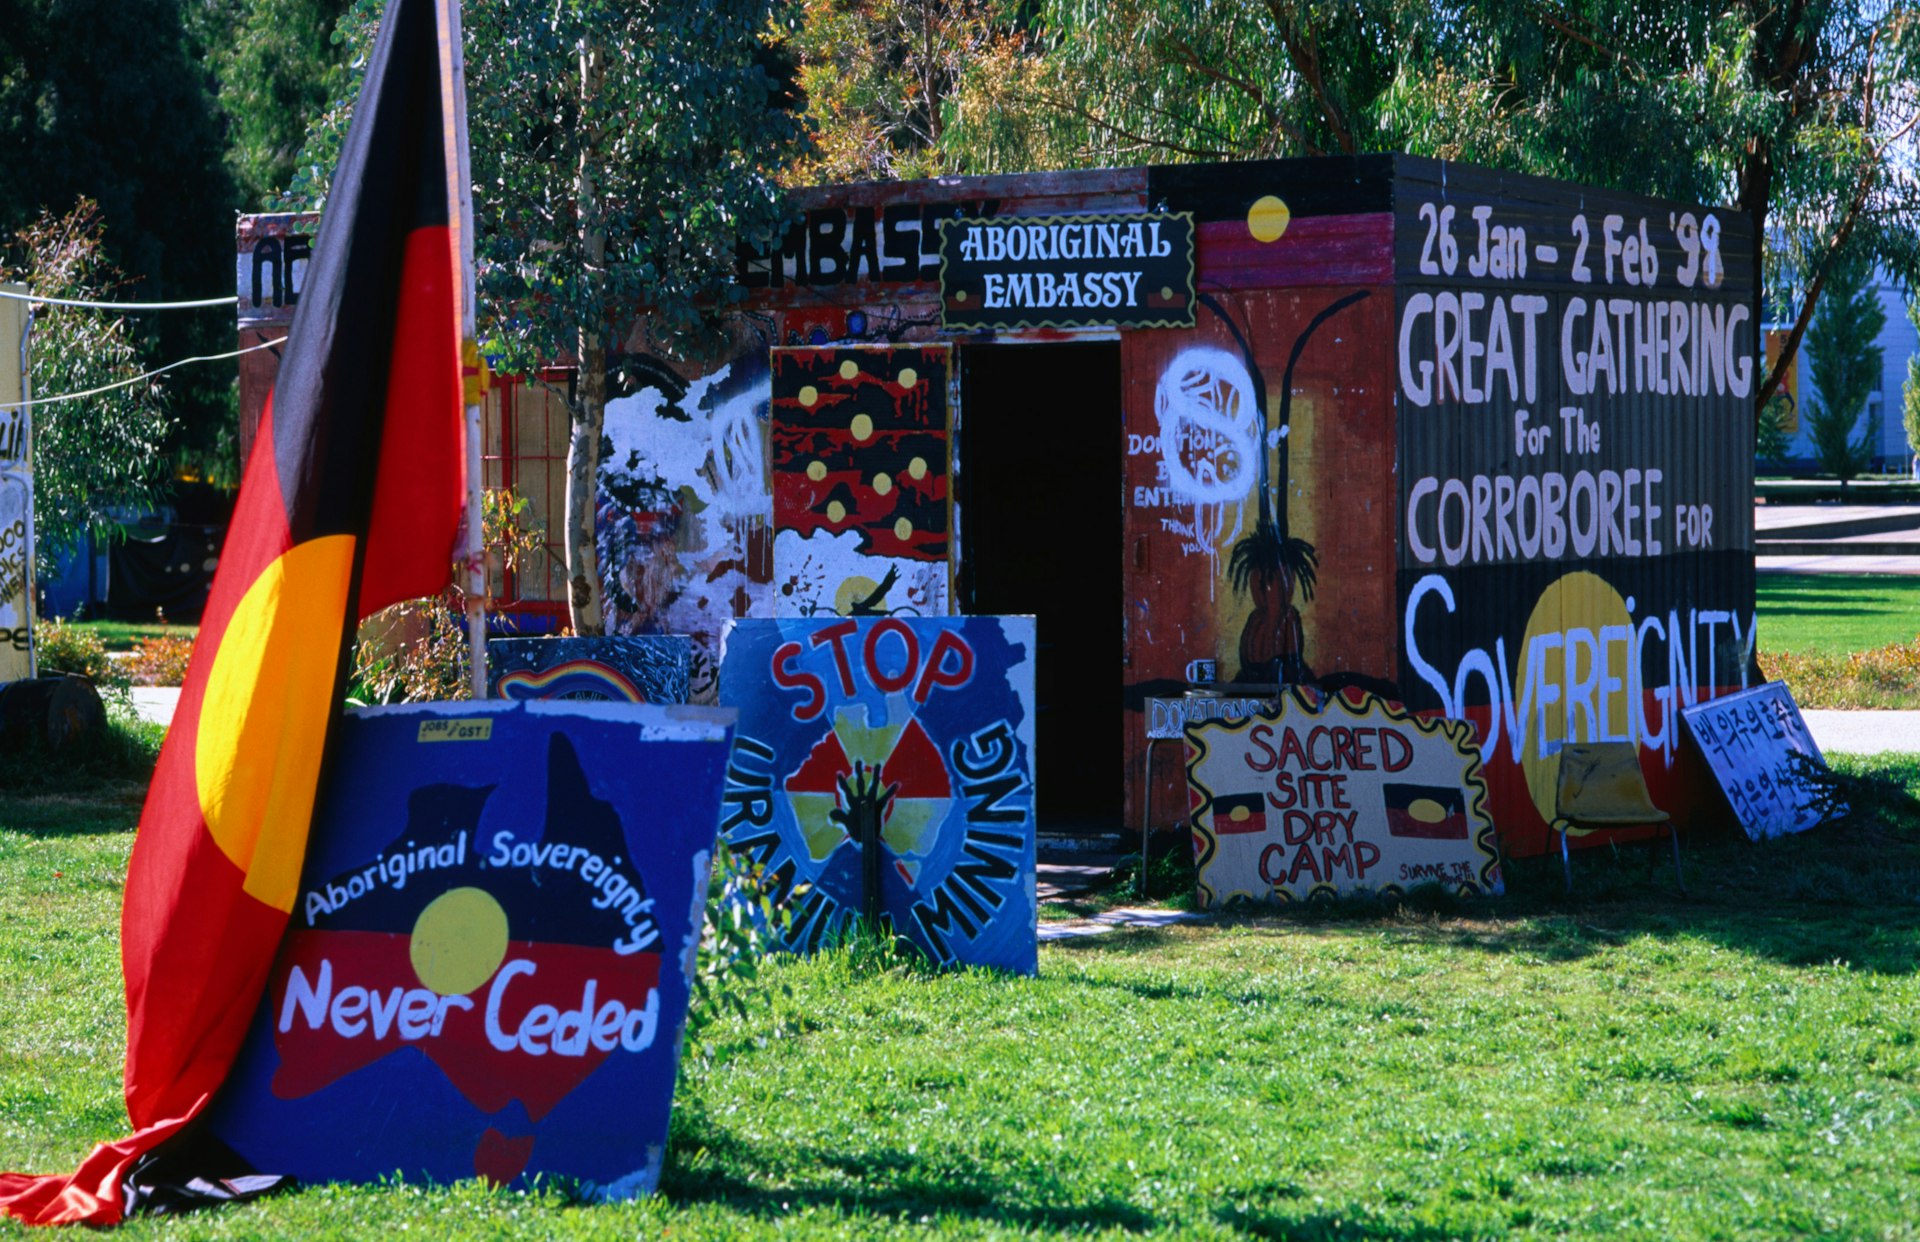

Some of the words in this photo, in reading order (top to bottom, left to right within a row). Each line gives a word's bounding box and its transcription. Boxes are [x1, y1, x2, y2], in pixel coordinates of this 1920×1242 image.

[735, 199, 1000, 288] EMBASS
[959, 221, 1172, 262] ABORIGINAL
[1419, 202, 1458, 277] 26
[1468, 206, 1527, 279] Jan
[1571, 214, 1592, 283] 2
[1603, 214, 1659, 287] Feb
[983, 272, 1143, 309] EMBASSY
[1399, 292, 1549, 407] GREAT
[1561, 297, 1754, 399] GATHERING
[1559, 406, 1601, 455] The
[1408, 468, 1664, 567] CORROBOREE
[1676, 503, 1713, 548] FOR
[772, 618, 976, 723] STOP
[422, 720, 449, 732] JOBS
[1244, 725, 1414, 773] SACRED
[1267, 772, 1352, 810] SITE
[911, 718, 1027, 966] MINING
[1283, 810, 1358, 846] DRY
[305, 831, 466, 928] Aboriginal
[488, 831, 660, 957] Sovereignty
[1259, 841, 1381, 886] CAMP
[278, 958, 474, 1040] Never
[484, 959, 660, 1057] Ceded
